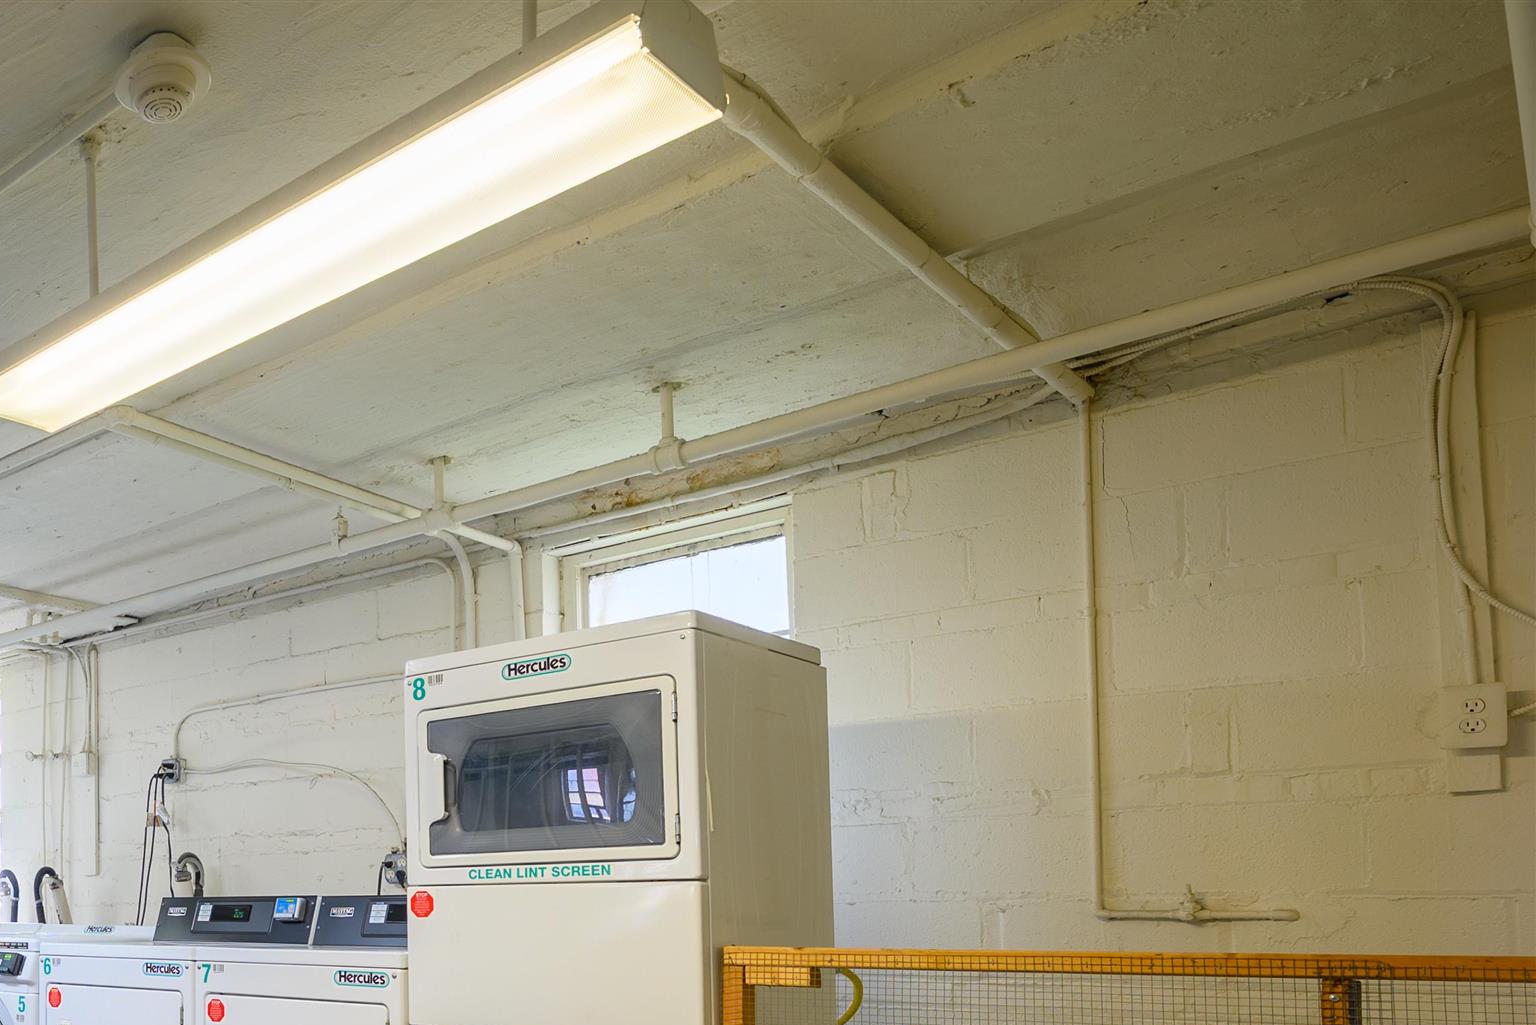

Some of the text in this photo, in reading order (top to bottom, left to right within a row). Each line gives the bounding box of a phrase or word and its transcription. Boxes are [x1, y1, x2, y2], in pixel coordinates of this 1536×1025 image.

[507, 656, 567, 677] Hercules
[413, 677, 426, 701] 8
[468, 864, 611, 880] CLEAN LINT SCREEN
[44, 957, 52, 975] 6
[145, 962, 181, 975] Hercules
[202, 964, 211, 983] 7
[338, 970, 386, 986] Hercules
[18, 995, 26, 1013] 5
